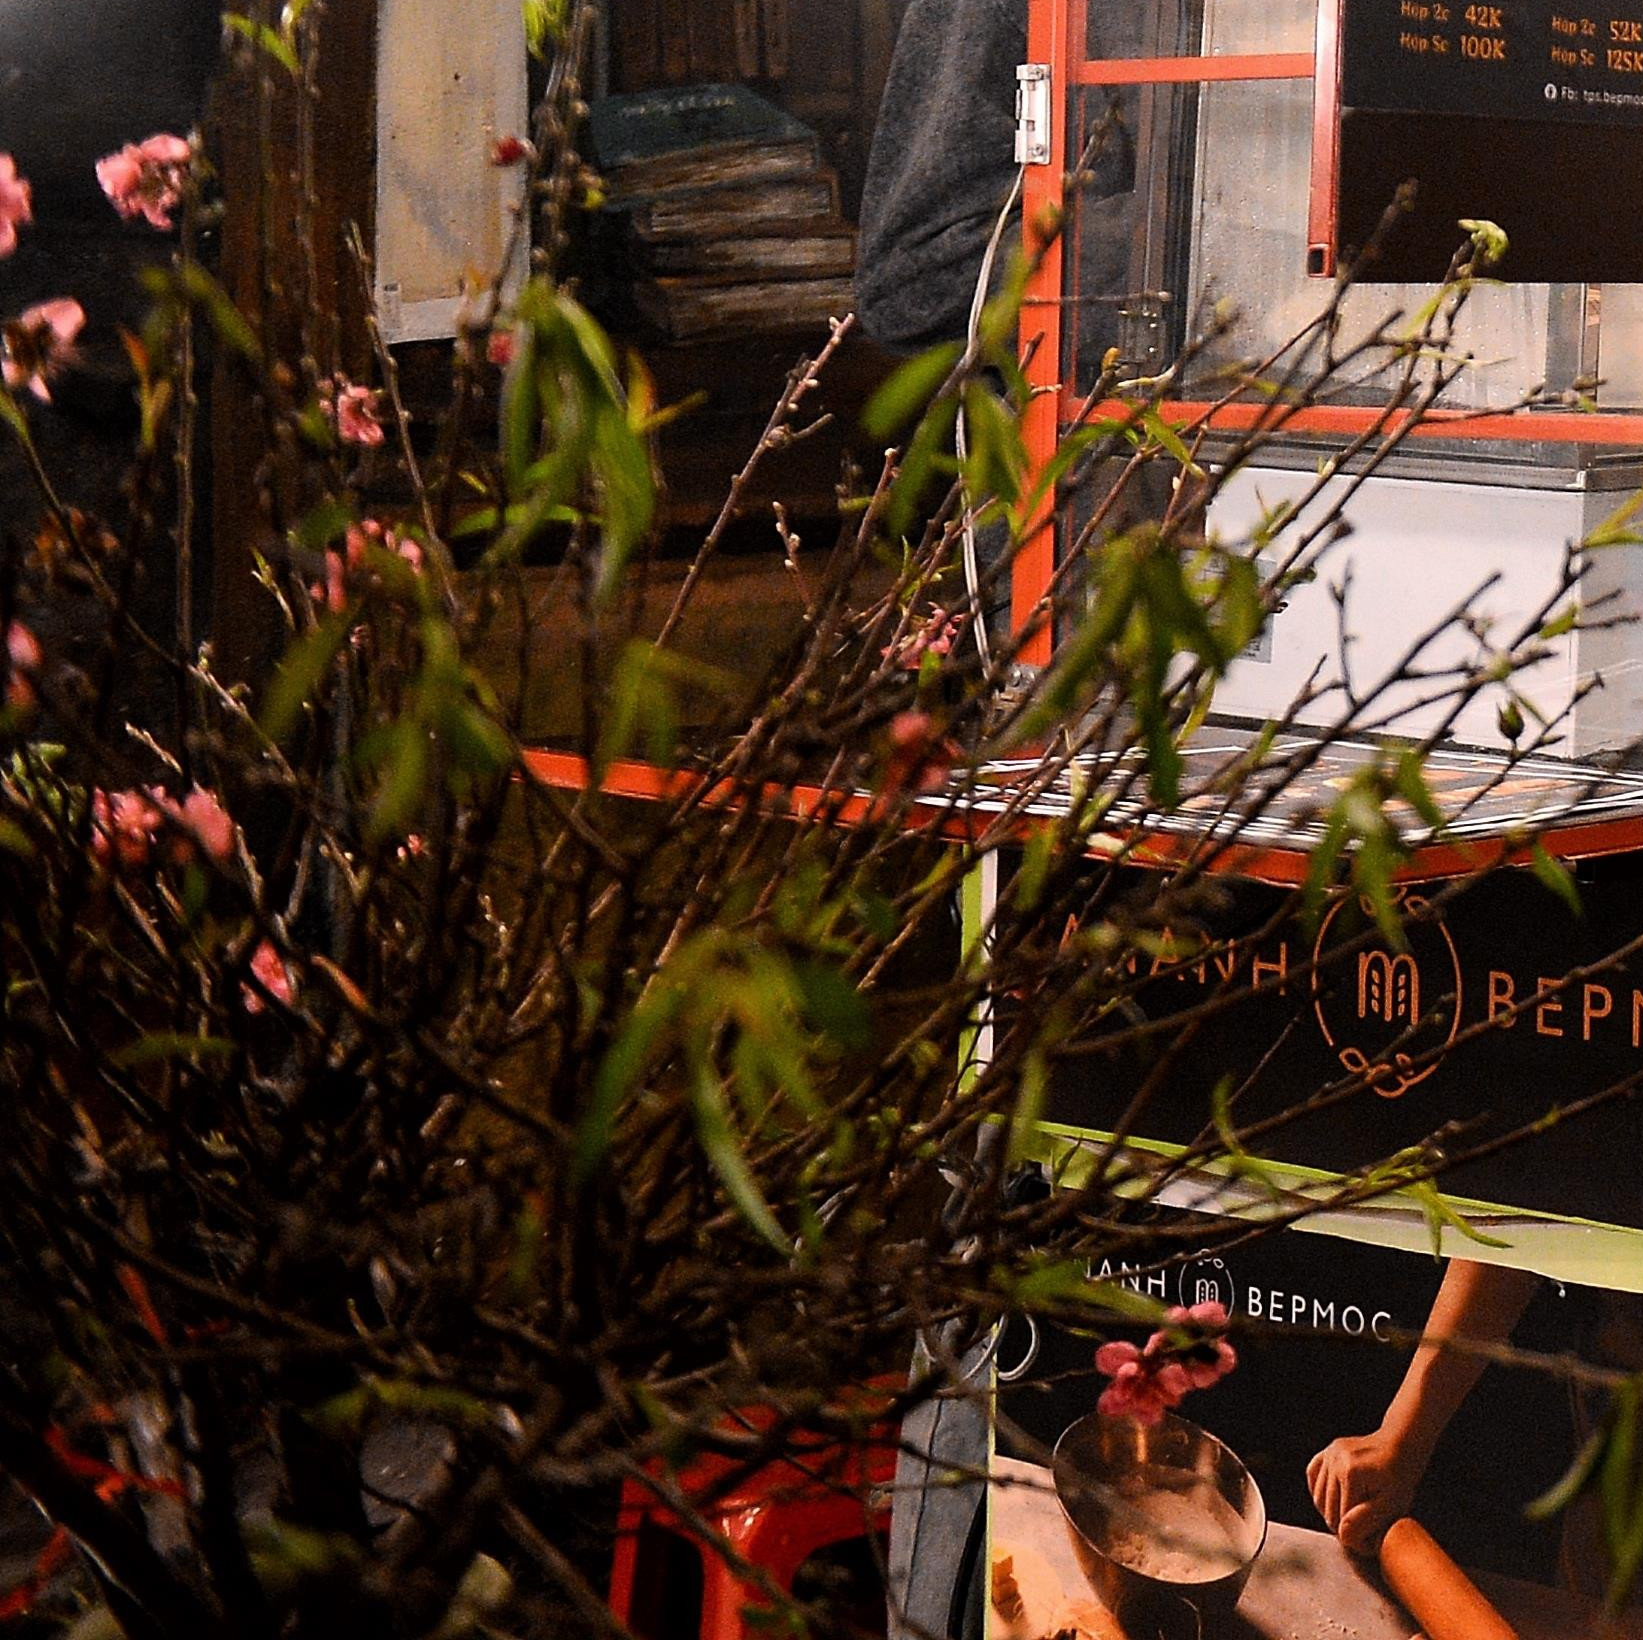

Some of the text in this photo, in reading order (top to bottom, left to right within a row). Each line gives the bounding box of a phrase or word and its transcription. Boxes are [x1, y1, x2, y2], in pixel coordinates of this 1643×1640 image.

[1464, 3, 1504, 29] 42K
[1608, 19, 1643, 43] 52K
[1459, 34, 1506, 60] 100K
[1247, 1285, 1393, 1343] BEPMOC
